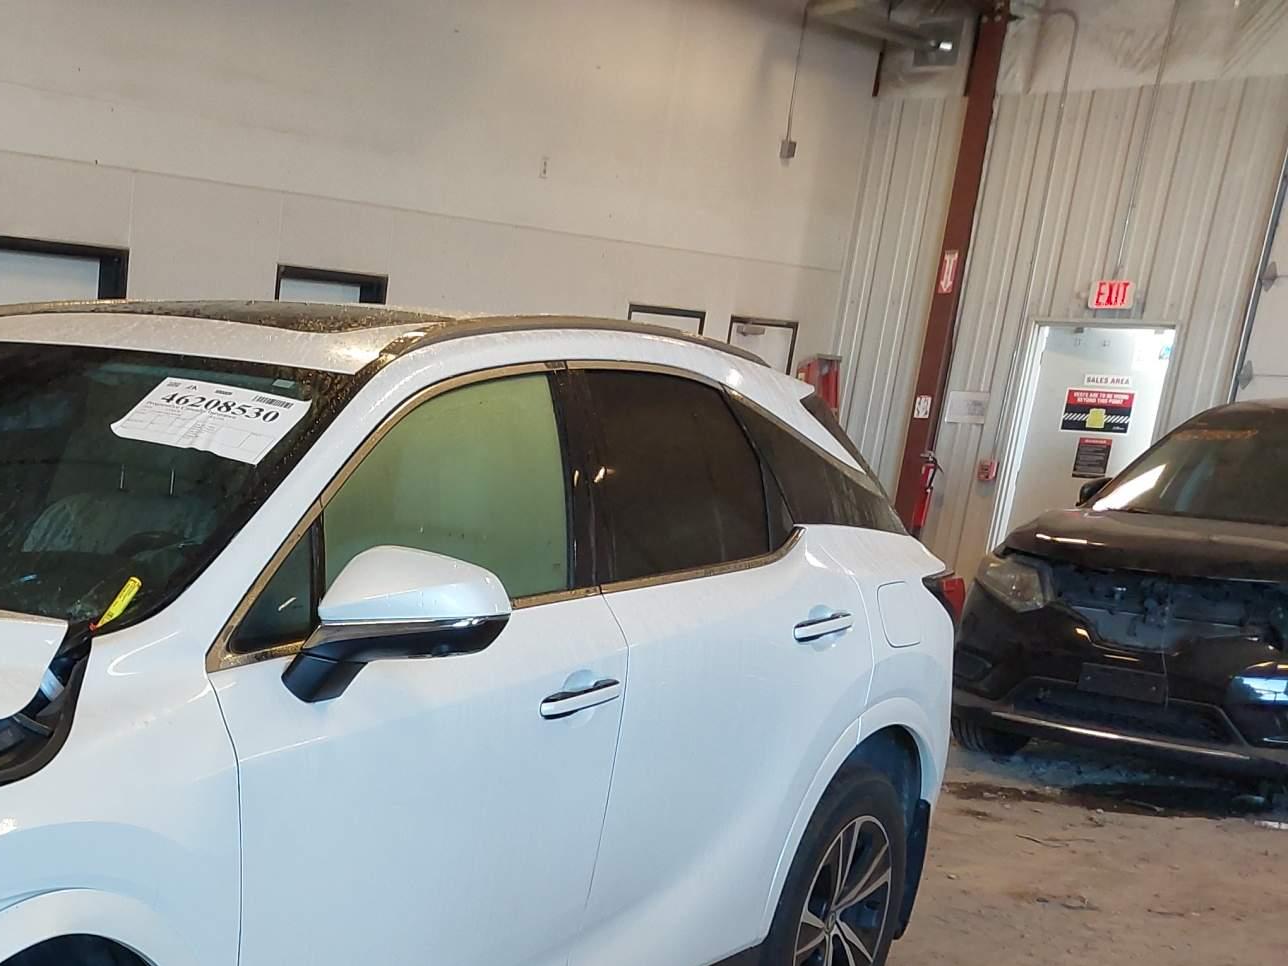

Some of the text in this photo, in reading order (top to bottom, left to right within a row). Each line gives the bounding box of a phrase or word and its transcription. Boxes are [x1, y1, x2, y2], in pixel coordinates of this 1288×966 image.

[1095, 282, 1130, 306] EXIT
[1086, 376, 1130, 385] SALES AREA
[161, 392, 280, 424] 46208530
